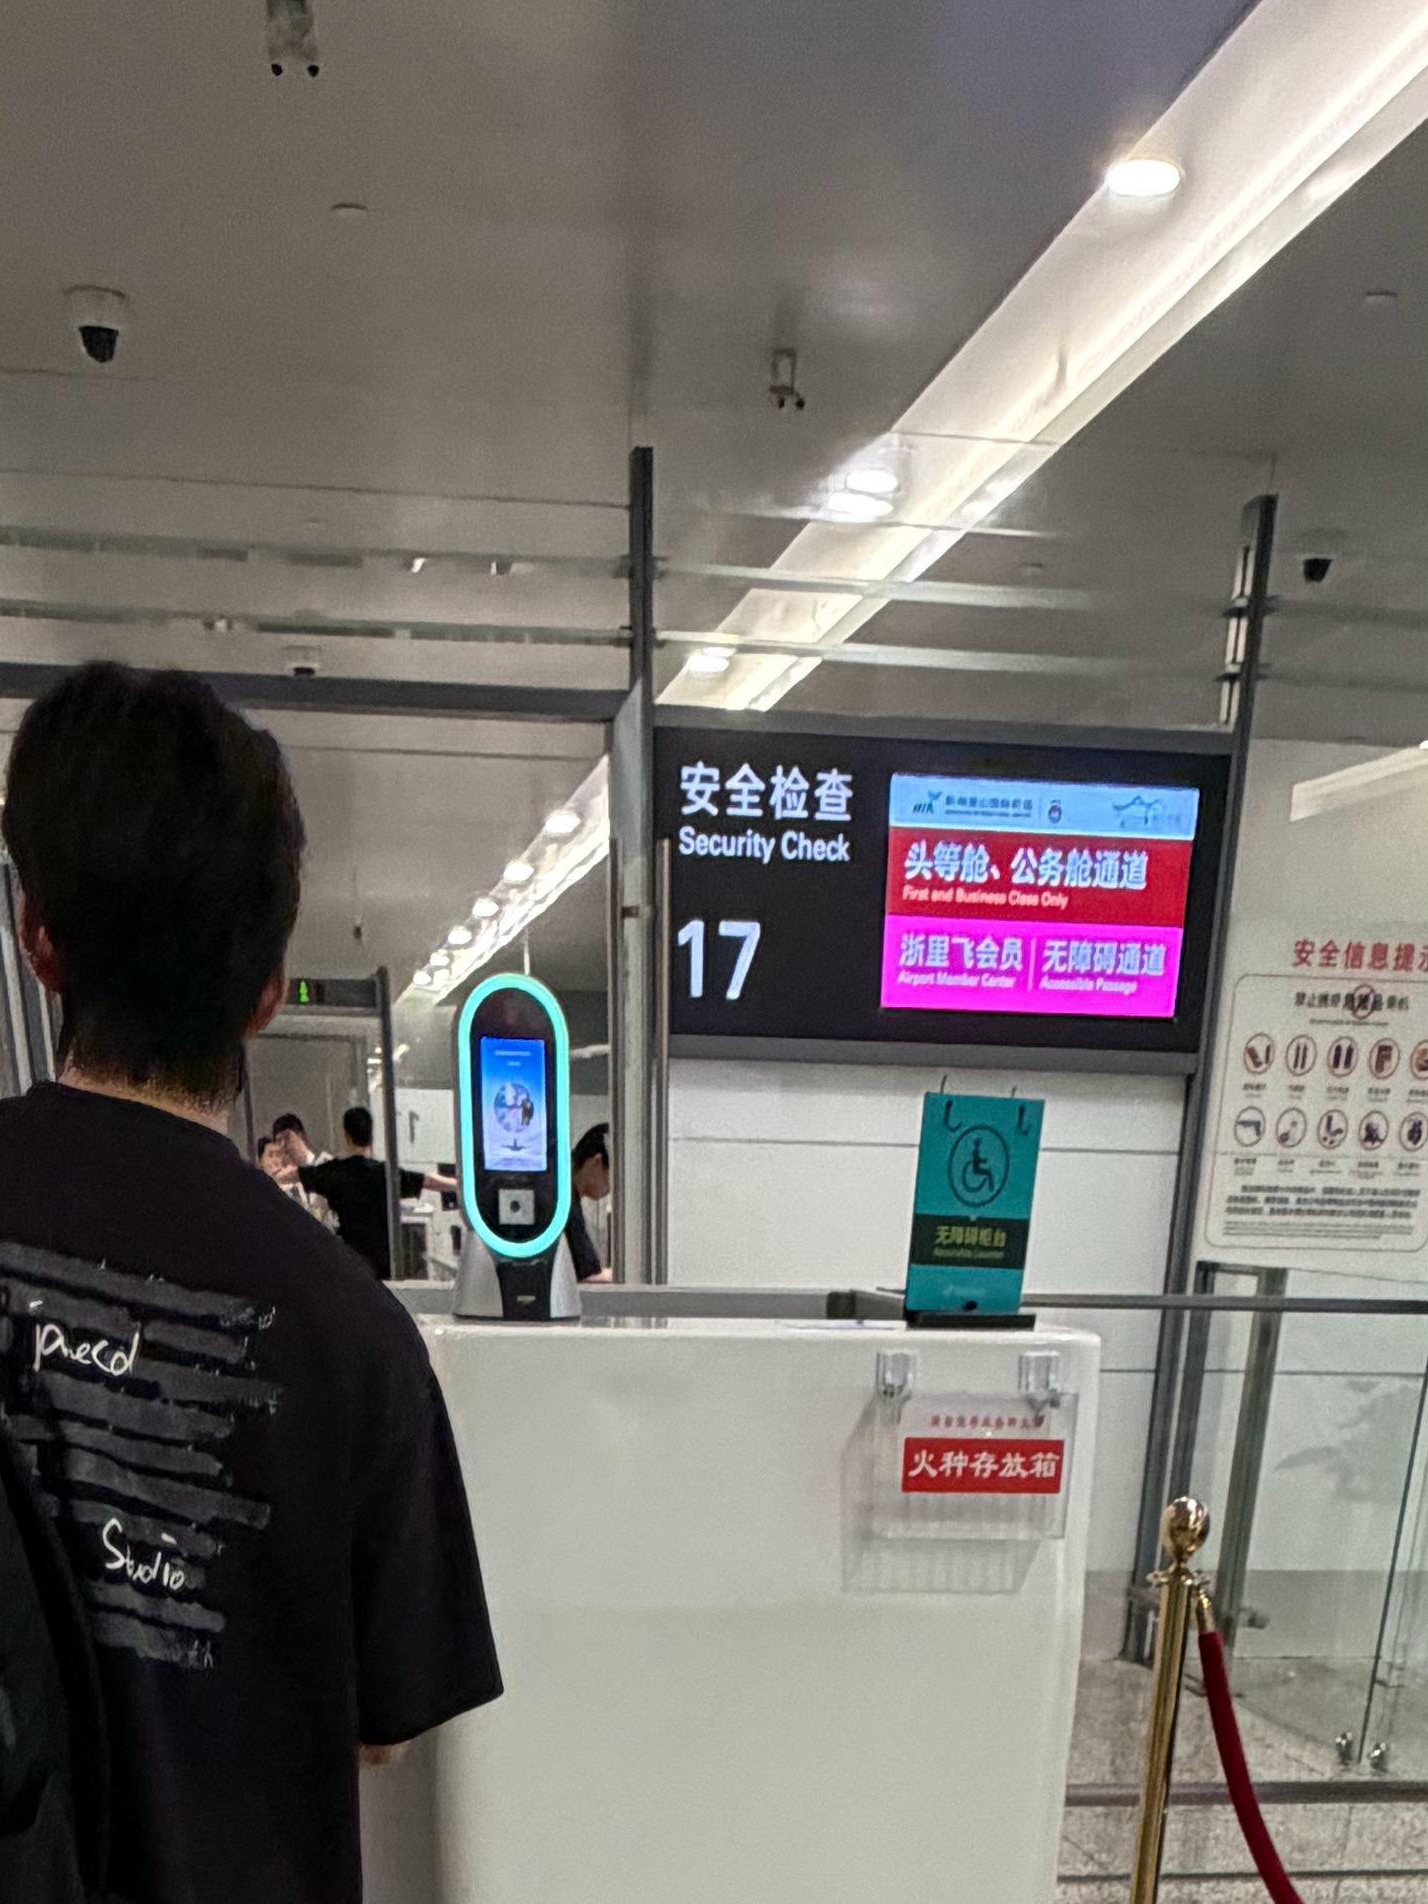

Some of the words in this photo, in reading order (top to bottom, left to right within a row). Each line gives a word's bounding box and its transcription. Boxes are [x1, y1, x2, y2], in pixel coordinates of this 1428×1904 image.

[680, 761, 853, 821] 安全检查
[678, 825, 776, 864] Security
[781, 829, 851, 861] Check
[904, 840, 1149, 891] 头等舱、公务舱通道
[903, 884, 929, 902] First
[931, 887, 953, 902] and
[1040, 891, 1069, 911] Only
[677, 919, 761, 1000] 17
[1042, 939, 1166, 977] 无障碍通道
[908, 1448, 1061, 1479] 火种存放箱
